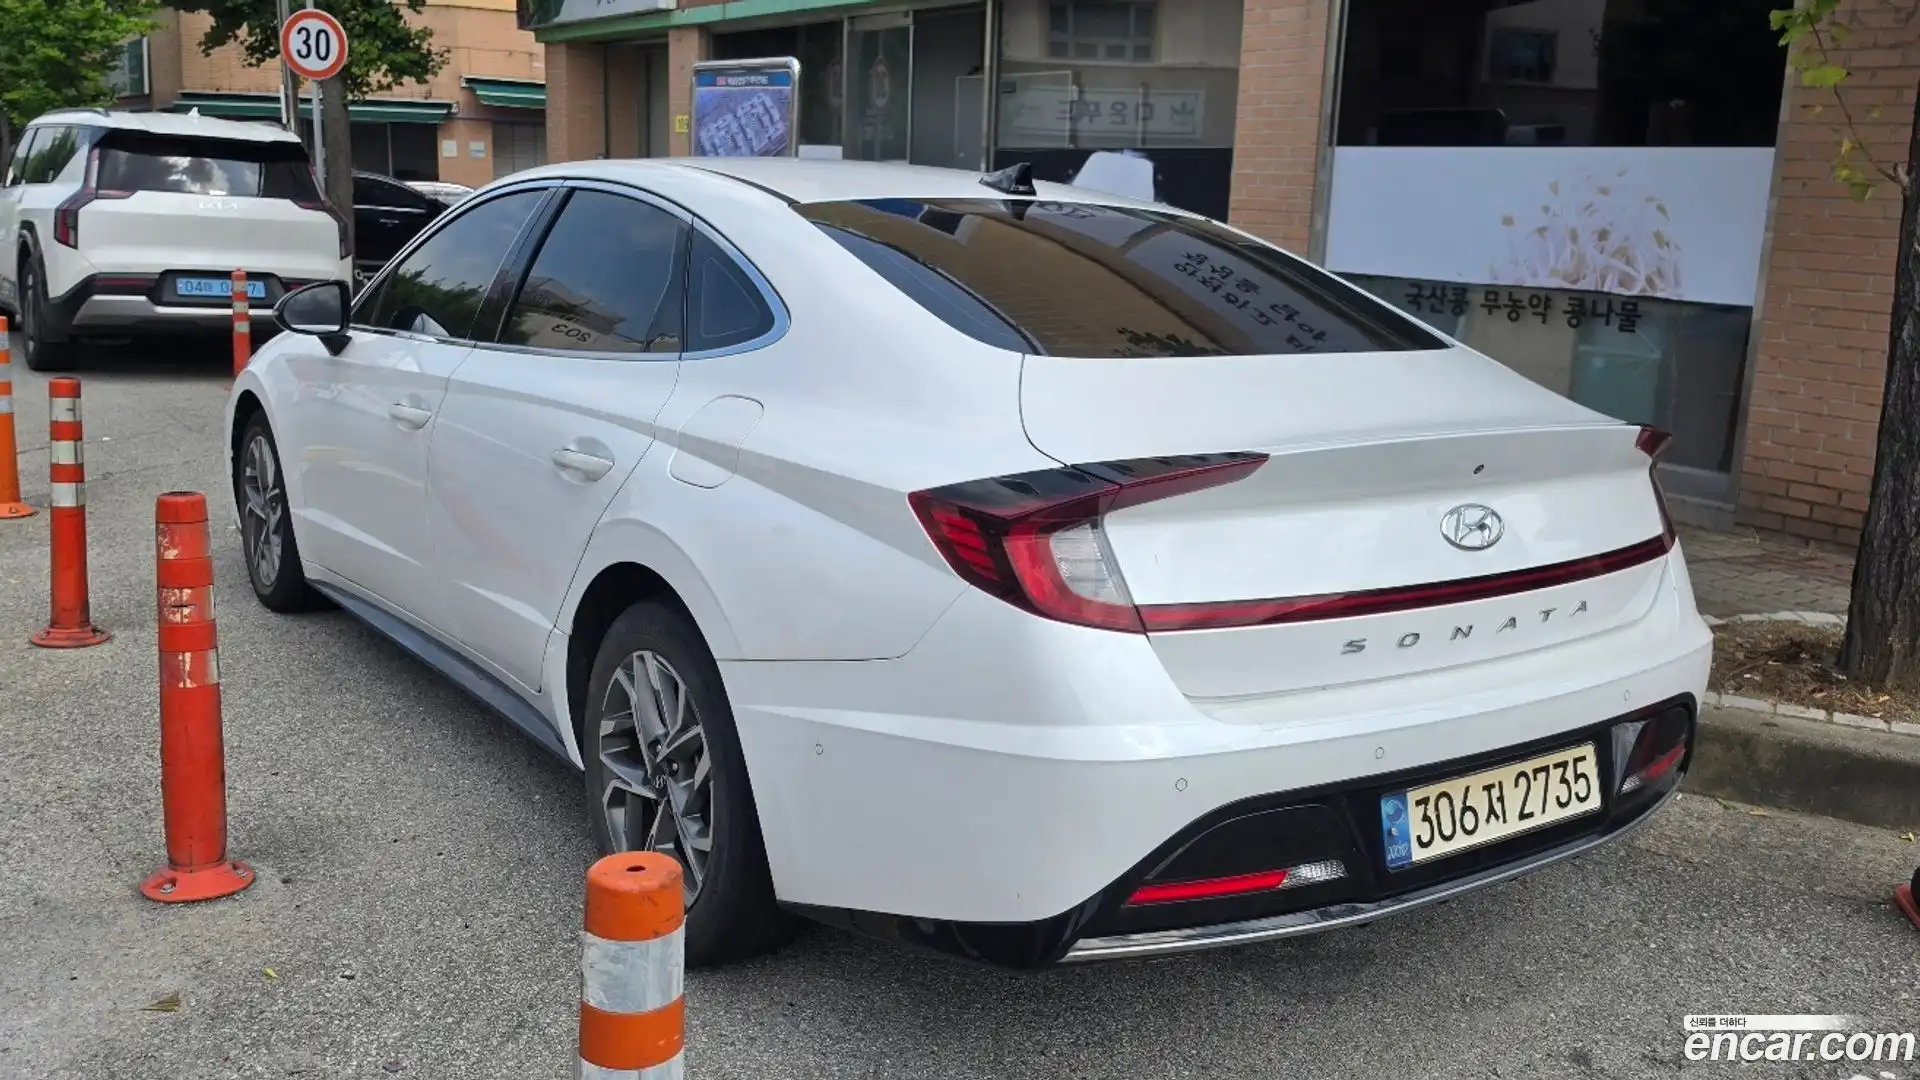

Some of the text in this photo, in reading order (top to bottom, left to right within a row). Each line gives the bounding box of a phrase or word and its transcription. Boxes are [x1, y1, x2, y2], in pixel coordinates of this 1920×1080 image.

[296, 26, 330, 61] 30
[1405, 282, 1642, 333] 국산콩 무농약 콩나물
[1340, 600, 1588, 655] SONATA
[1414, 755, 1592, 848] 306저 2735
